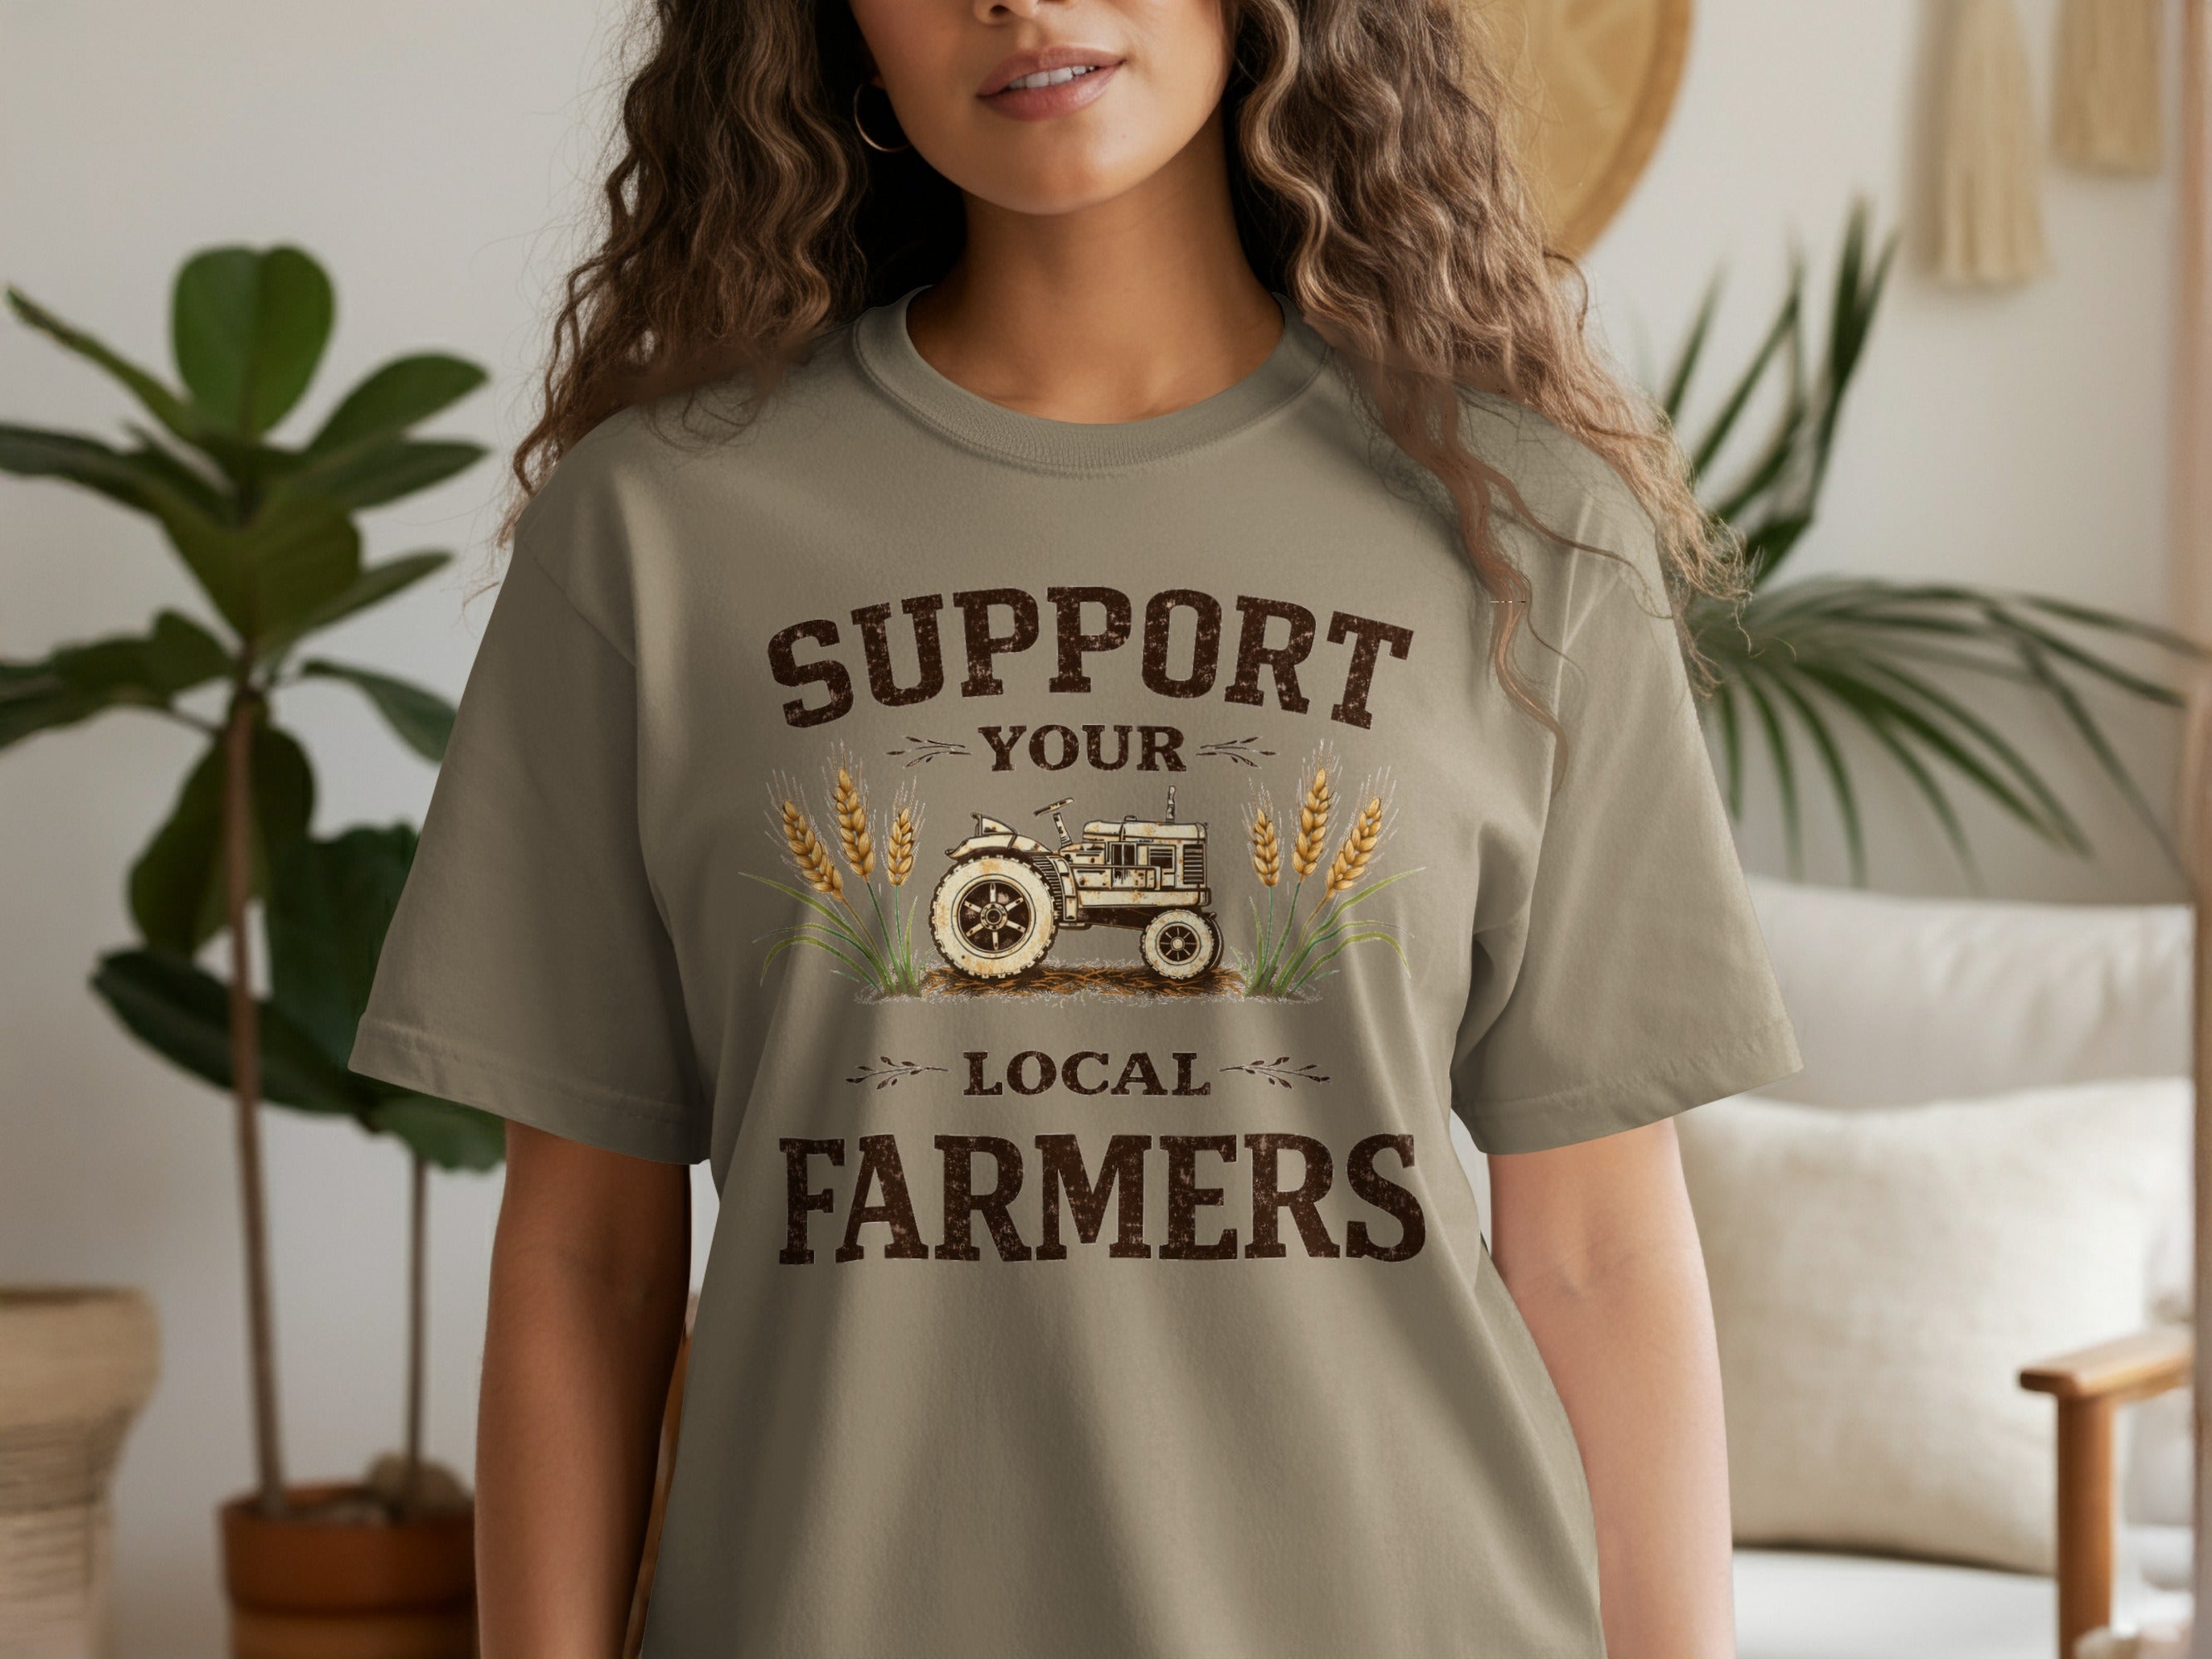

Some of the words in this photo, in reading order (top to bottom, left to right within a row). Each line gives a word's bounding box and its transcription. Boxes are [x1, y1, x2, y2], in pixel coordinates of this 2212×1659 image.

[767, 586, 1414, 730] SUPPORT
[978, 724, 1187, 772] YOUR
[962, 1050, 1211, 1097] LOCAL
[778, 1133, 1426, 1265] FARMERS
